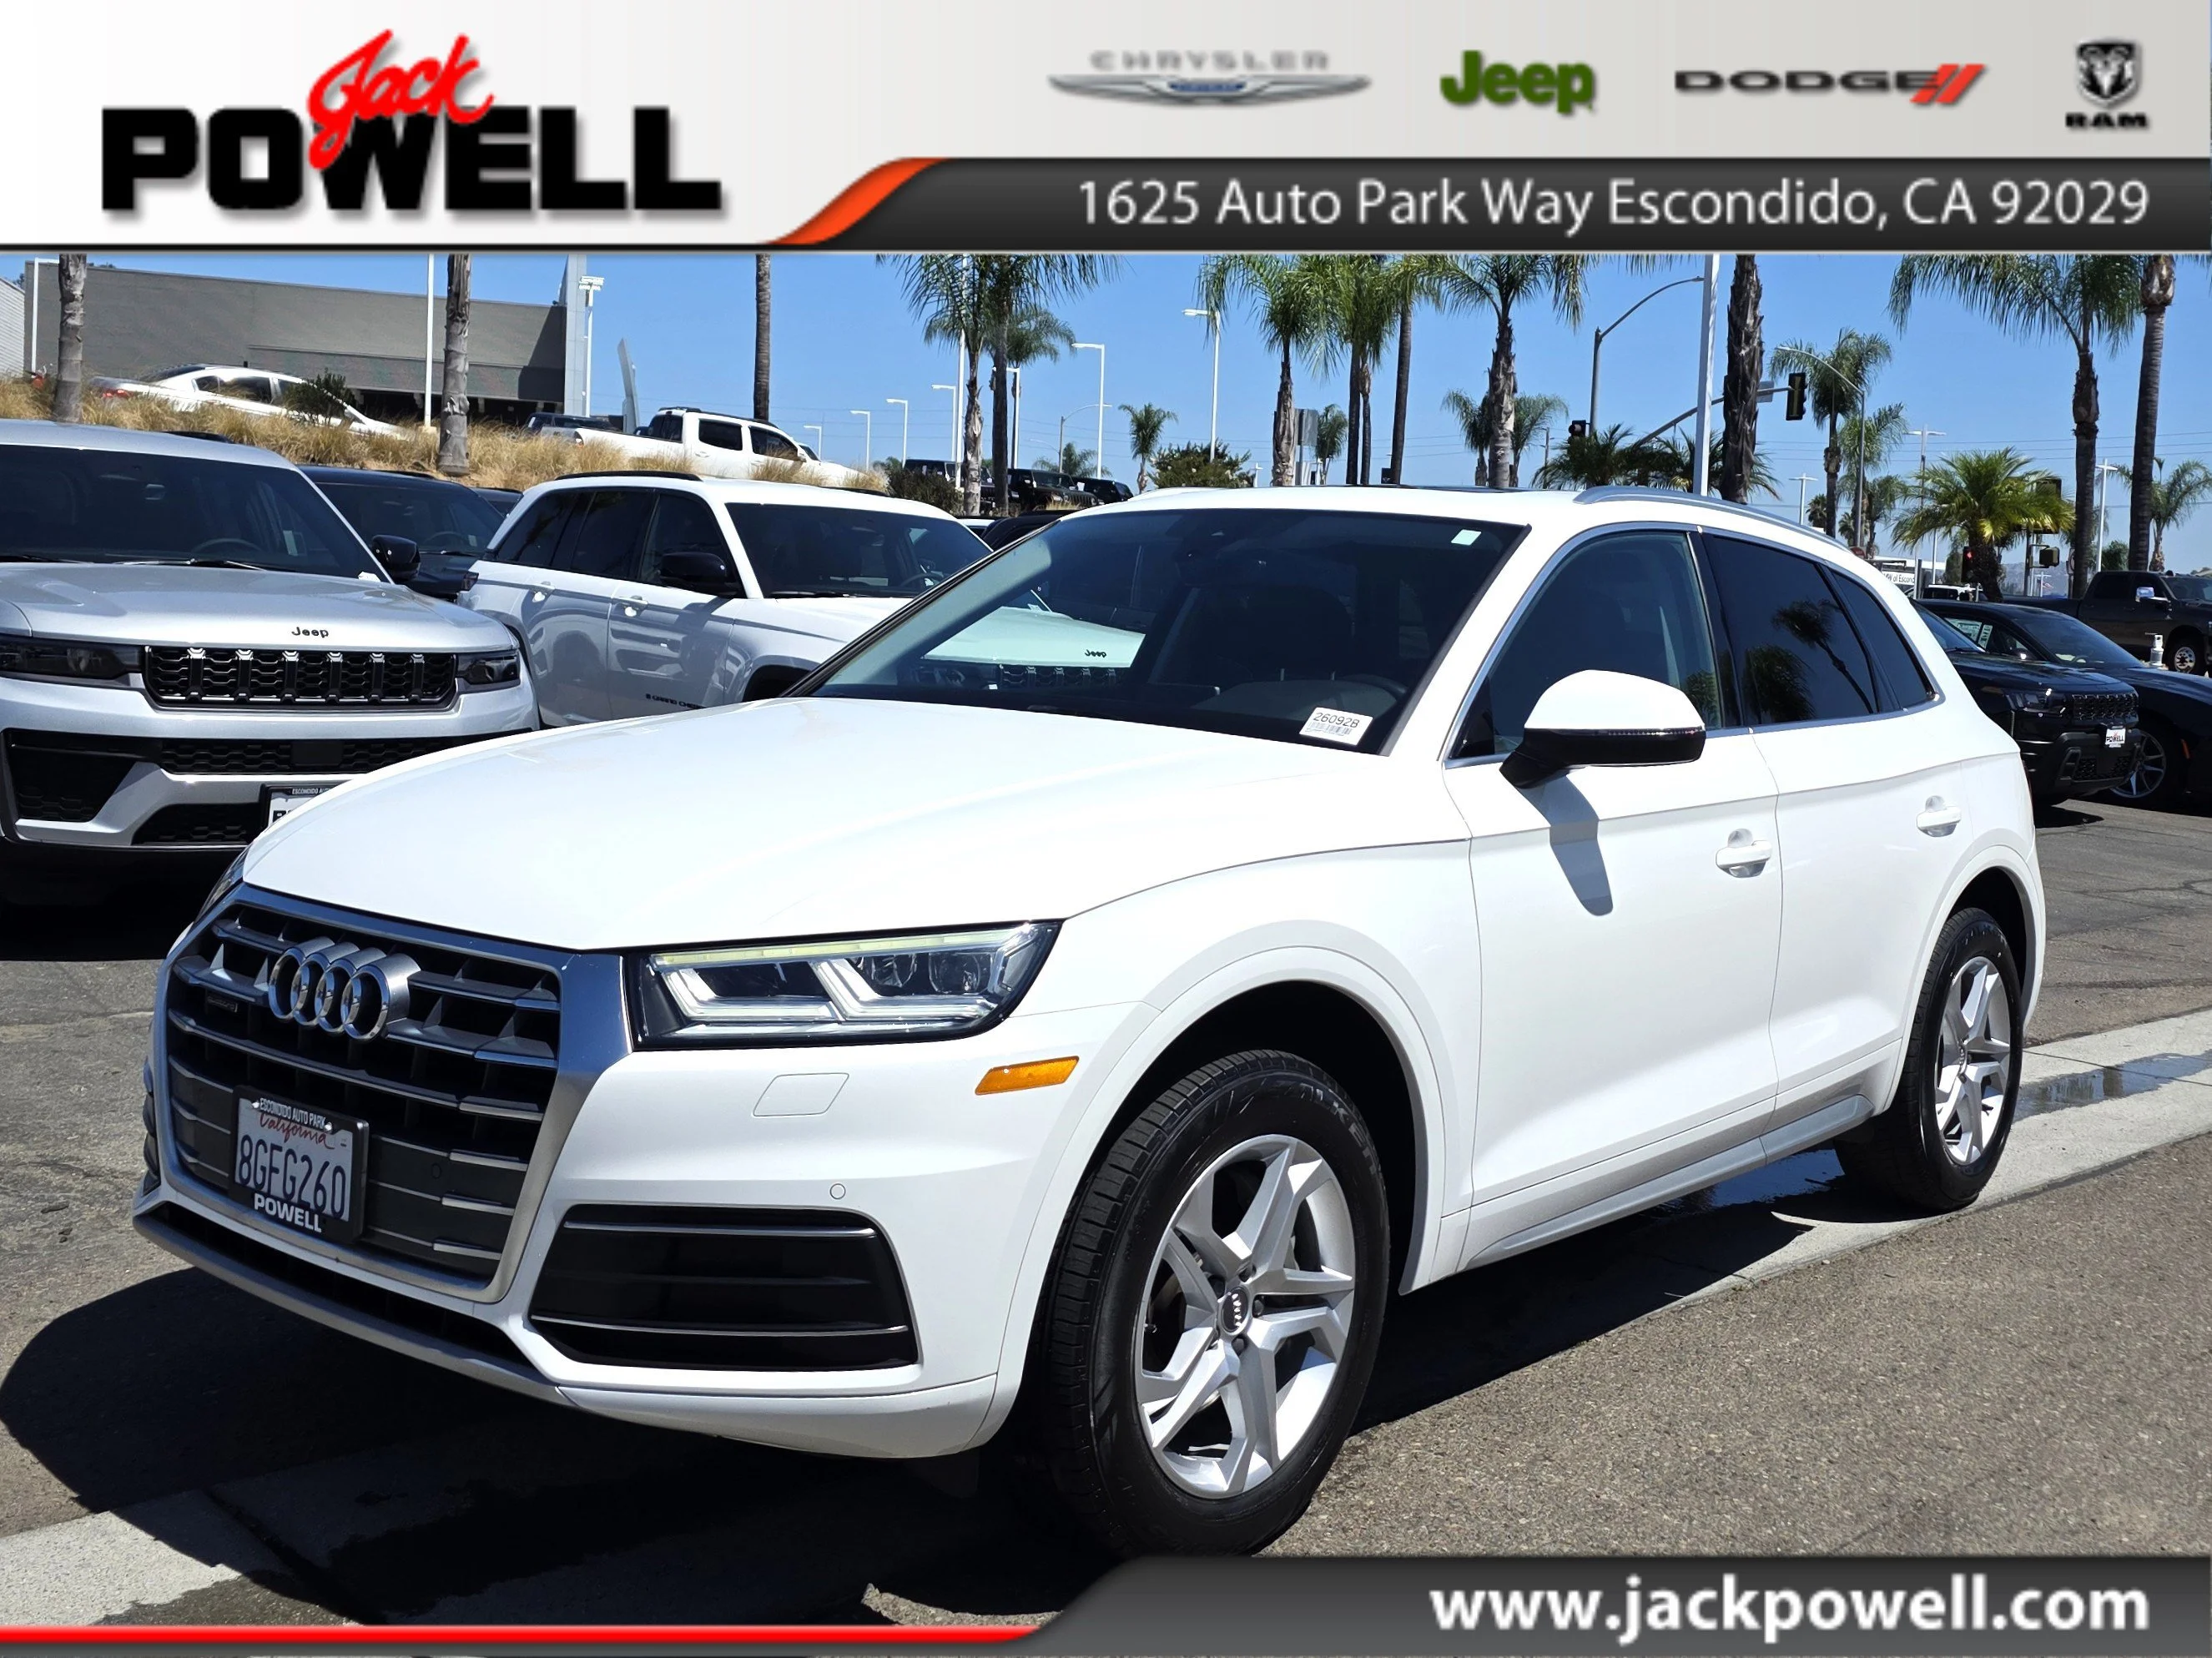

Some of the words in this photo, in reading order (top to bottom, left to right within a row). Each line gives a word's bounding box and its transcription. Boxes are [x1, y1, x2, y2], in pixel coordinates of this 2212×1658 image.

[291, 627, 329, 638] Jeep
[1084, 648, 1107, 658] Jeep
[259, 1097, 292, 1120] ESCONDIDO
[292, 1108, 309, 1125] AUTO
[309, 1113, 326, 1128] PARK
[259, 1113, 335, 1150] California
[238, 1134, 347, 1219] 8GFG260
[254, 1192, 322, 1233] POWELL
